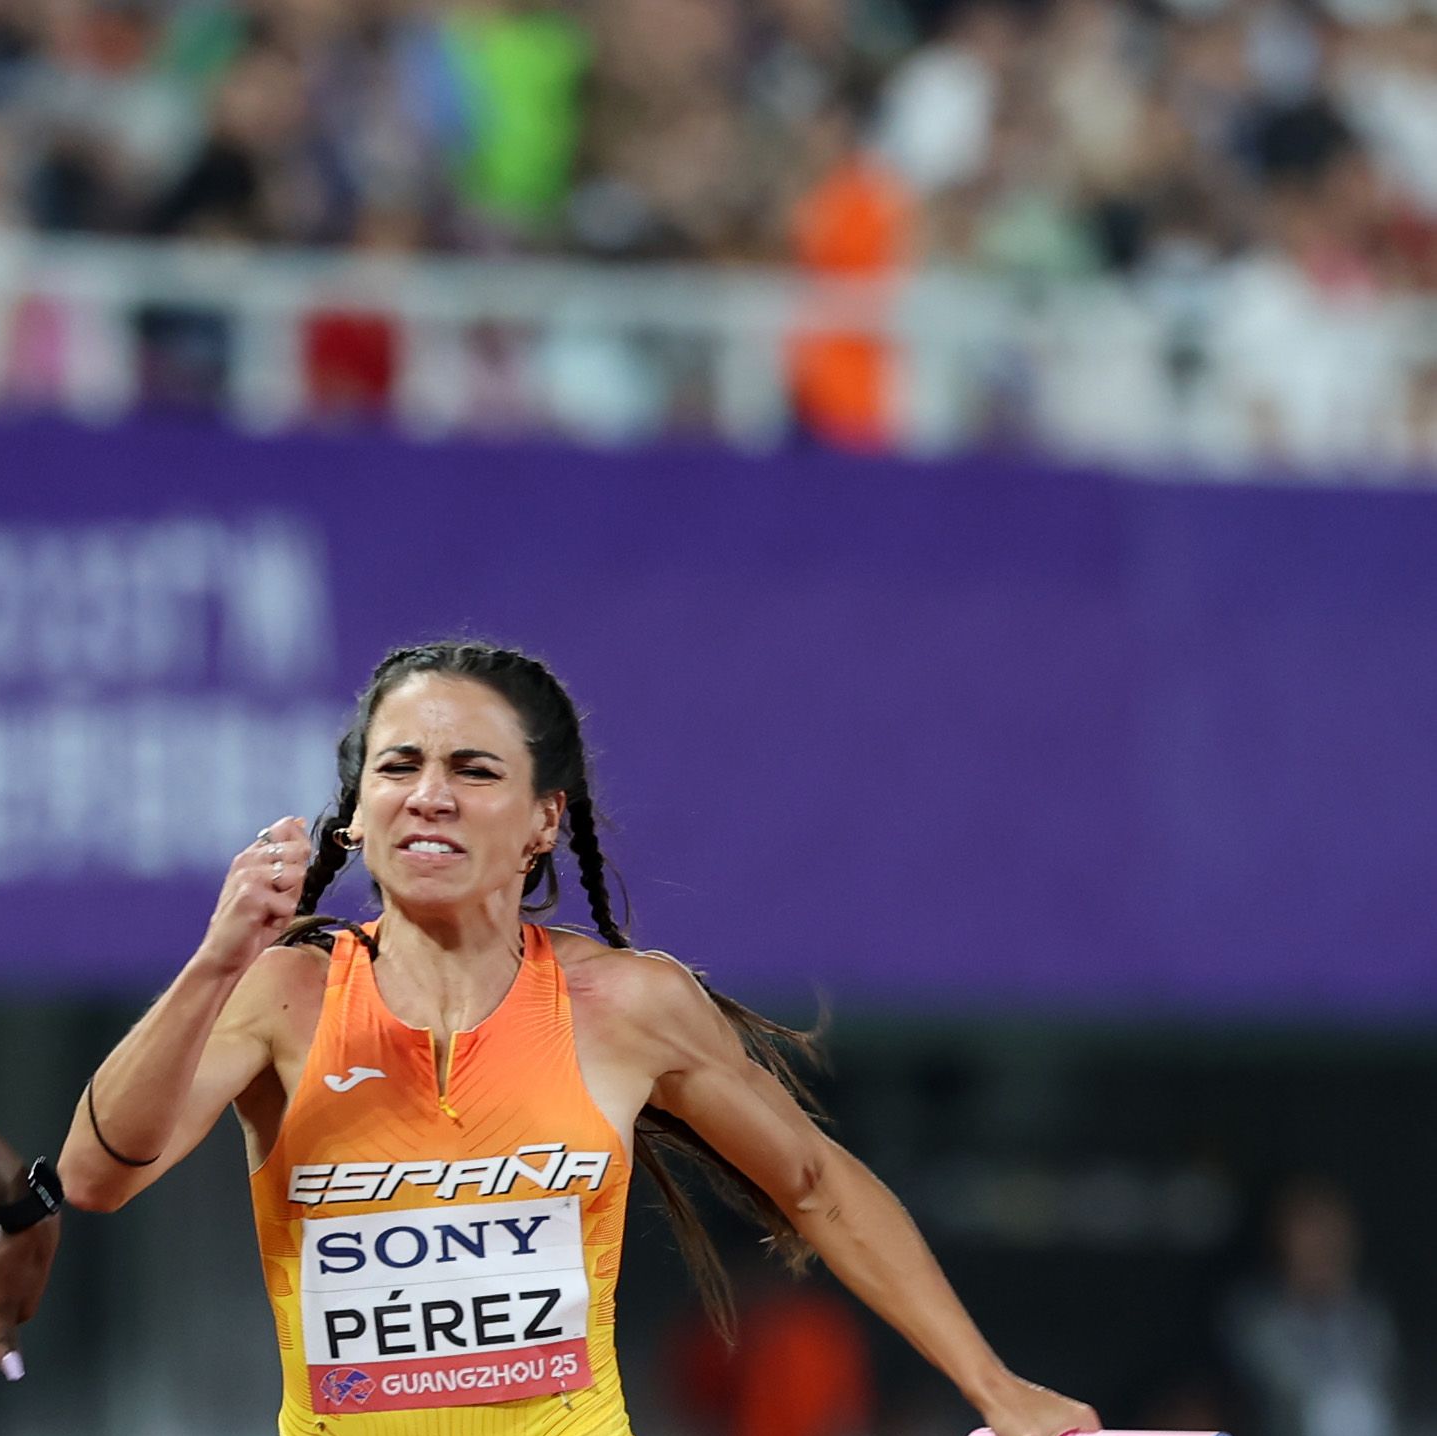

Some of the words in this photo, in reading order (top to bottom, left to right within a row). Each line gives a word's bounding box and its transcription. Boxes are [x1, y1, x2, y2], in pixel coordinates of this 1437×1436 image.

[287, 1142, 612, 1205] ESPAÑA
[316, 1214, 551, 1275] SONY
[324, 1288, 563, 1360] PÉREZ
[380, 1360, 545, 1396] GUANGZHOU
[550, 1353, 579, 1377] 25
